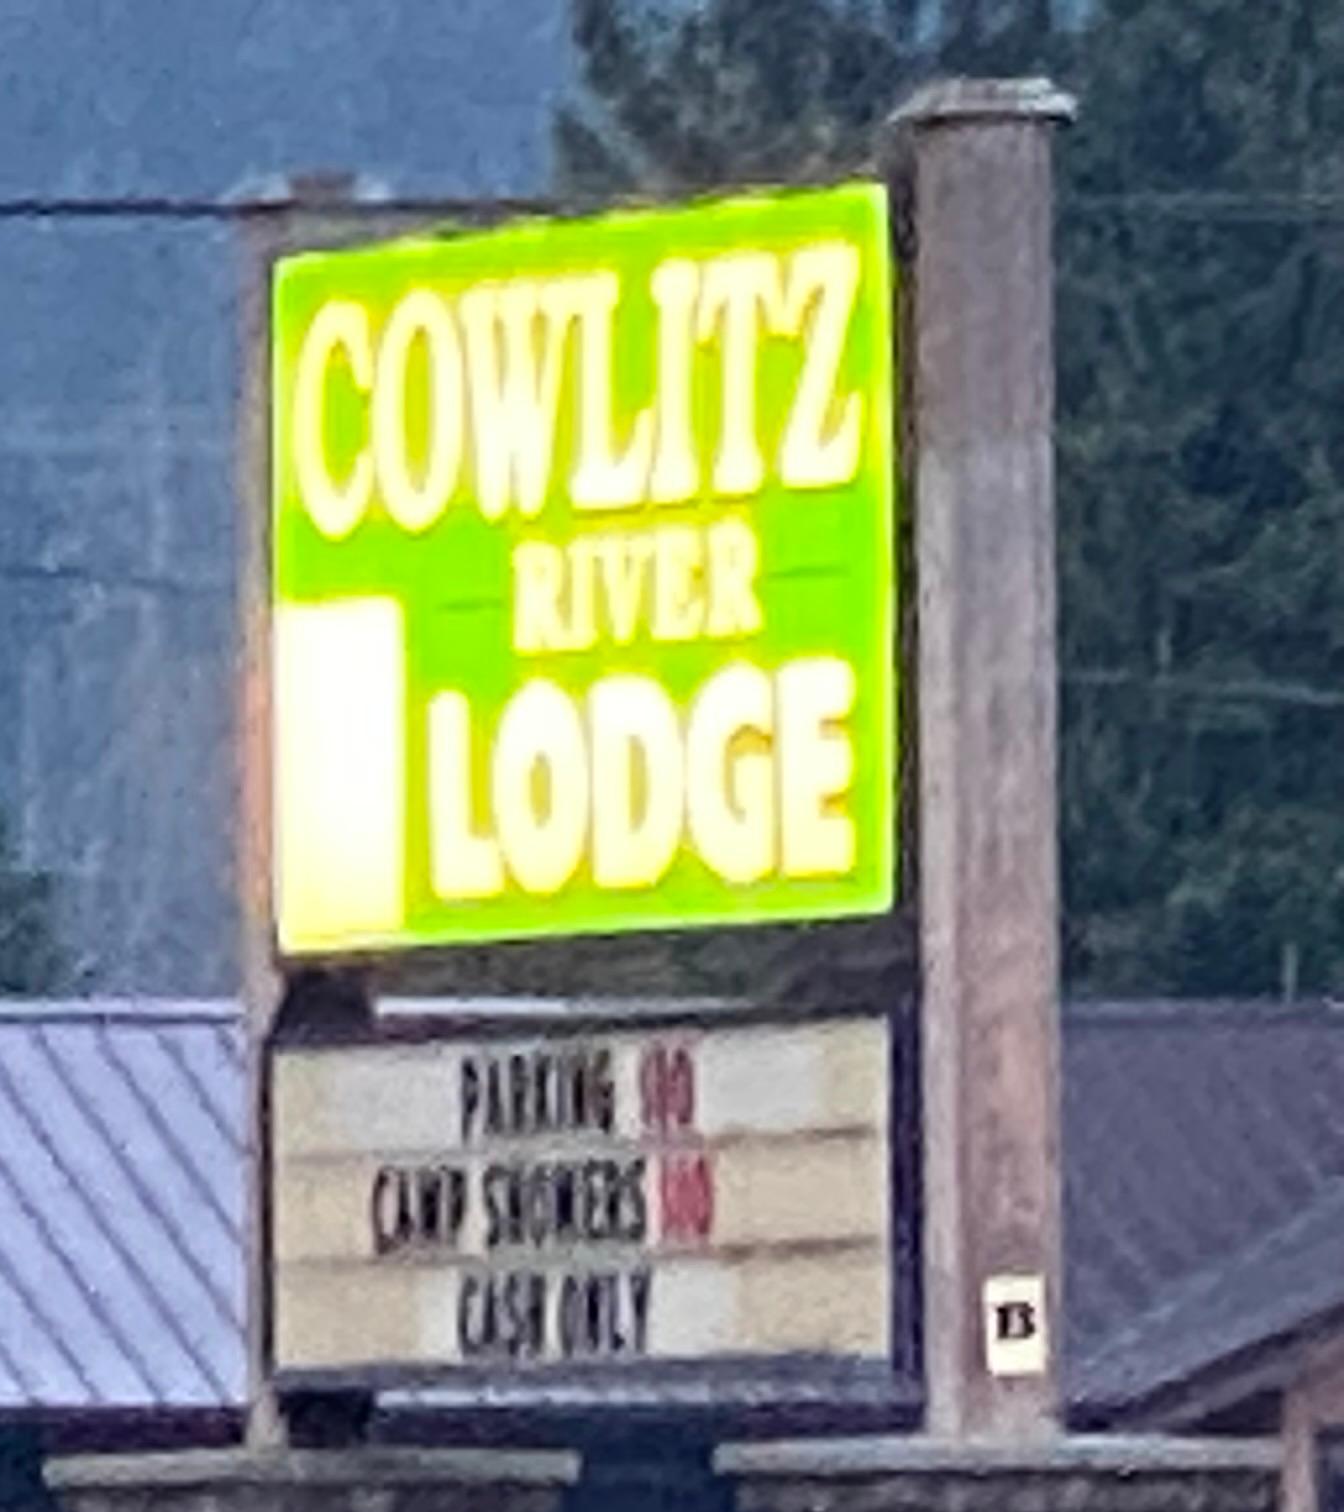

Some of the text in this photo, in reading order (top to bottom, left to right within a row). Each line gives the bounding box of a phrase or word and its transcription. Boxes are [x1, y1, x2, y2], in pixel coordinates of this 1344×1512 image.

[292, 240, 862, 537] COWLITZ
[512, 516, 763, 656] RIVER
[428, 656, 857, 900] LODGE
[459, 1047, 616, 1143] PARKING
[370, 1164, 468, 1255] CAMP
[481, 1157, 648, 1248] SHOWERS
[457, 1267, 653, 1357] CASH ONLY
